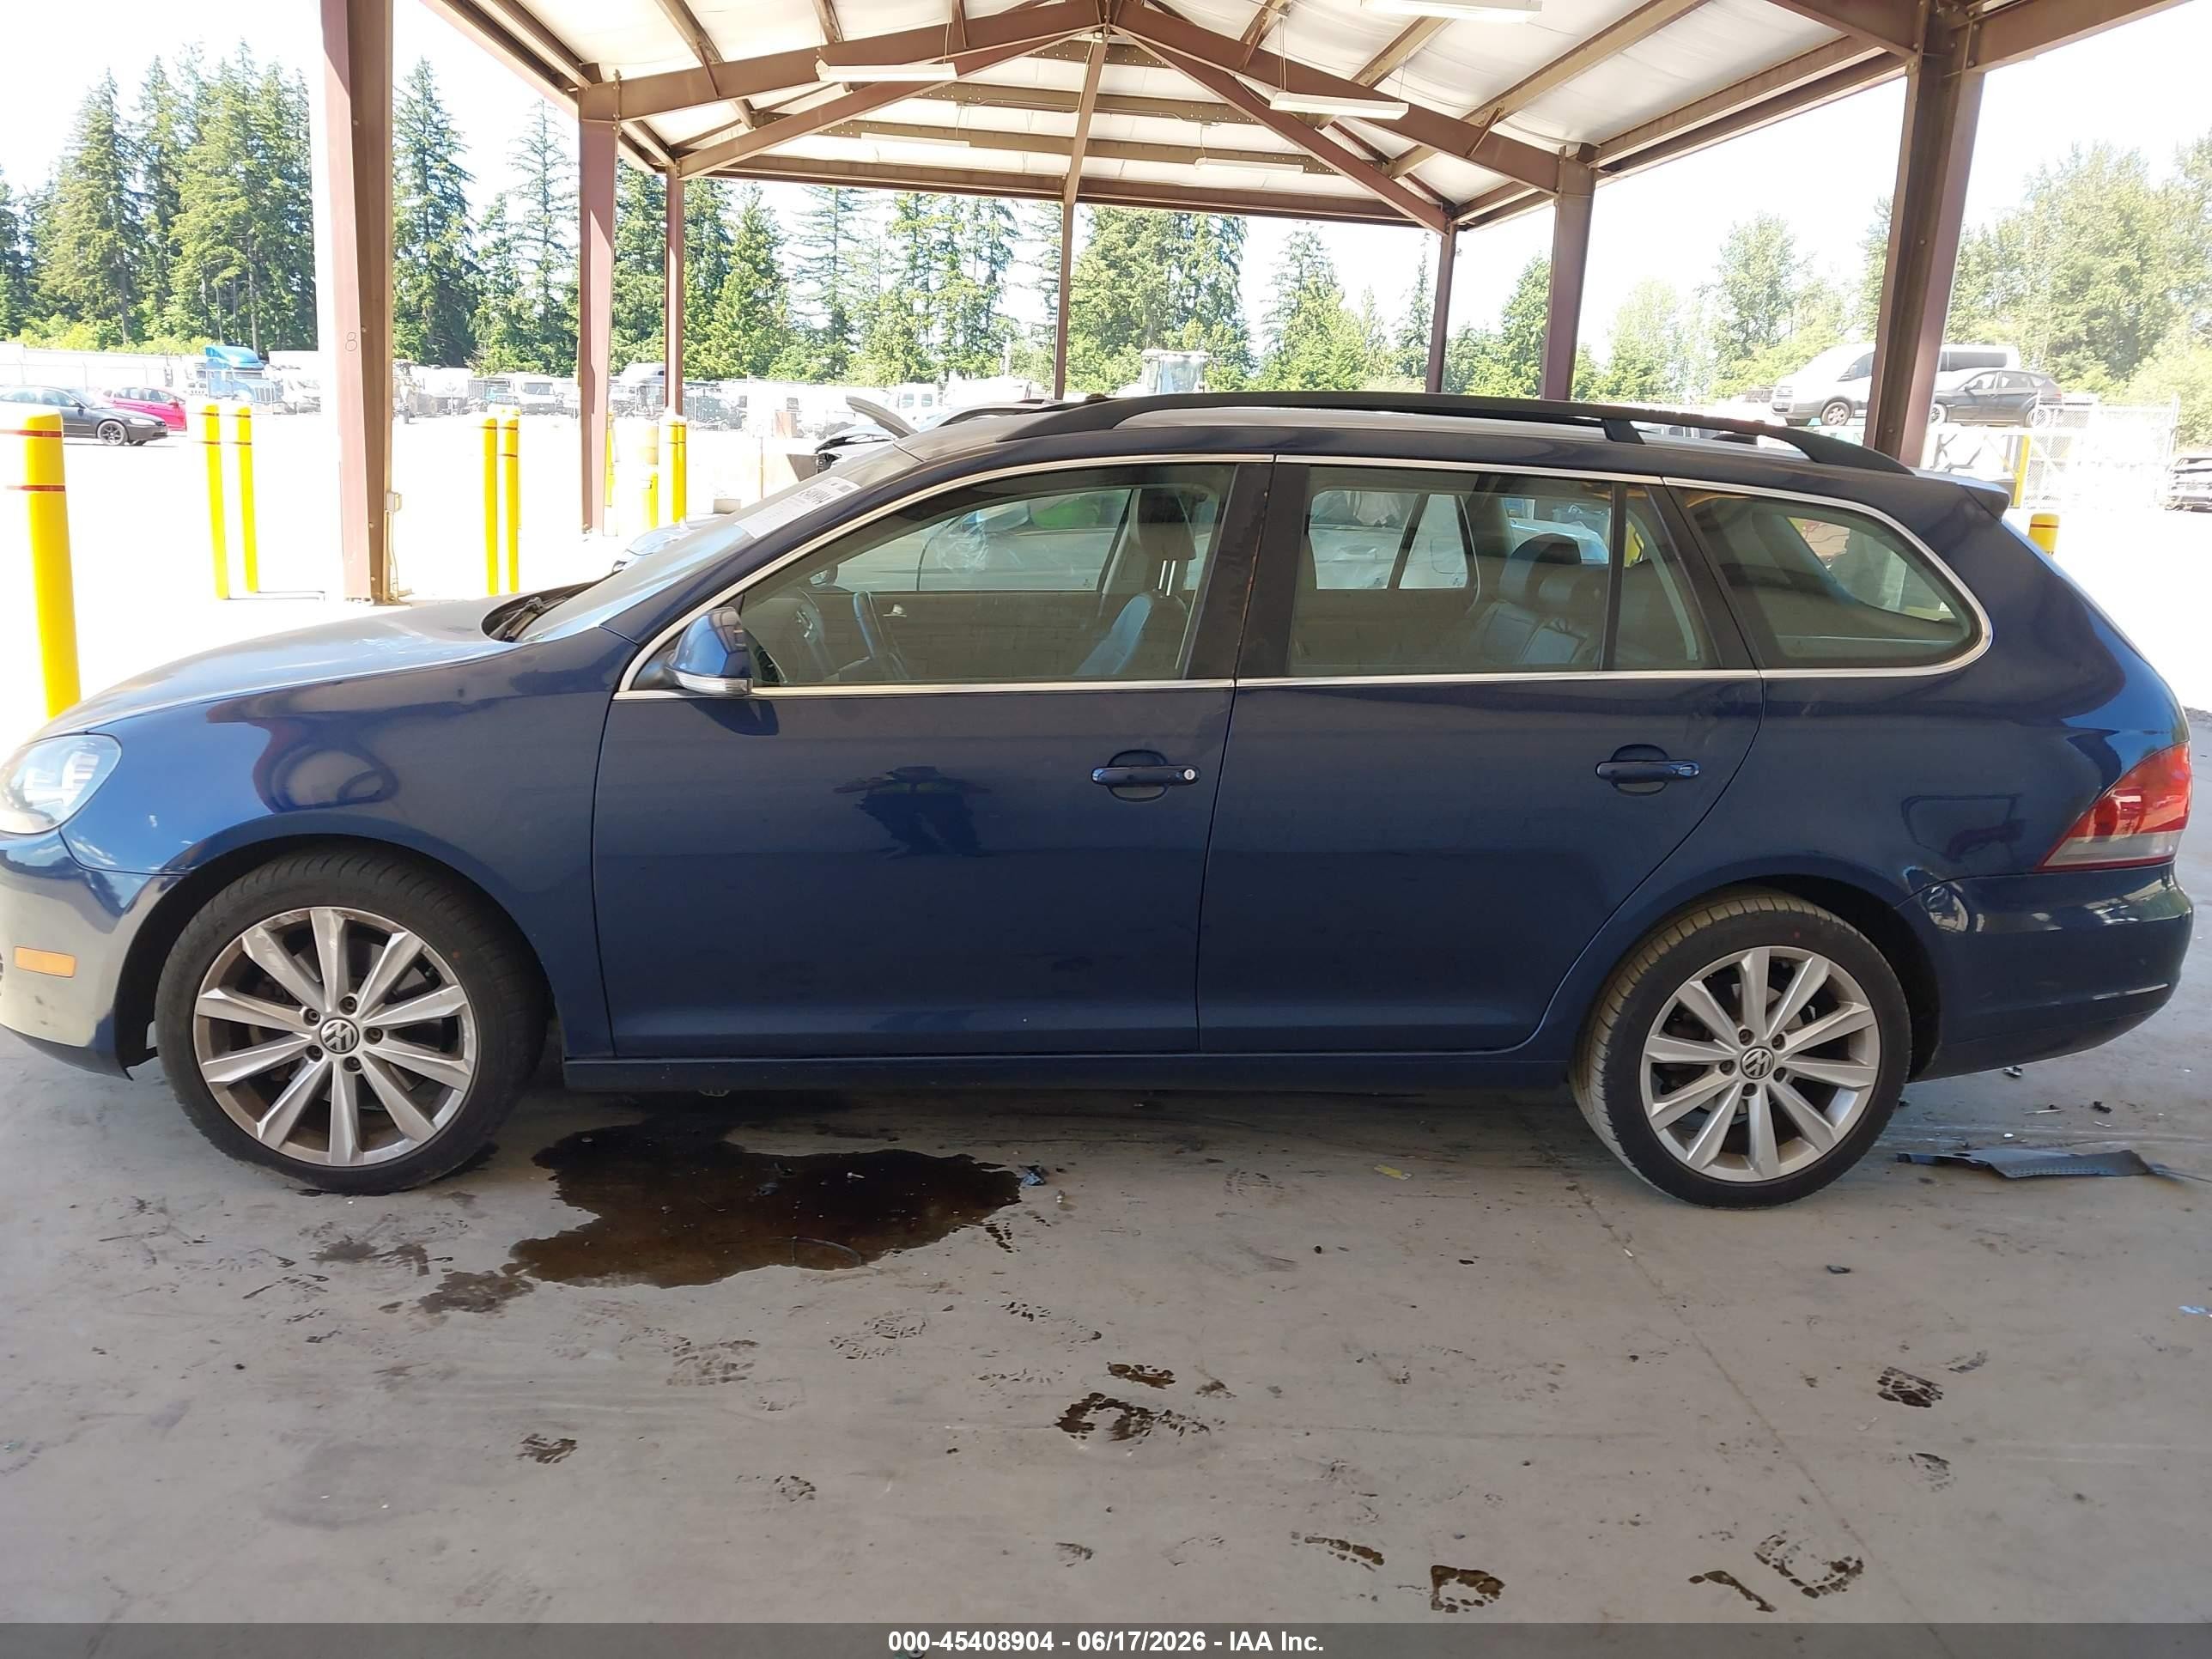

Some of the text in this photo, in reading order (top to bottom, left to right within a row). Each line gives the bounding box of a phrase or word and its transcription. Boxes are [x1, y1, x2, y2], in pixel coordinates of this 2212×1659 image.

[345, 331, 358, 352] 8
[321, 1018, 359, 1054] VW
[1741, 1047, 1773, 1079] VW
